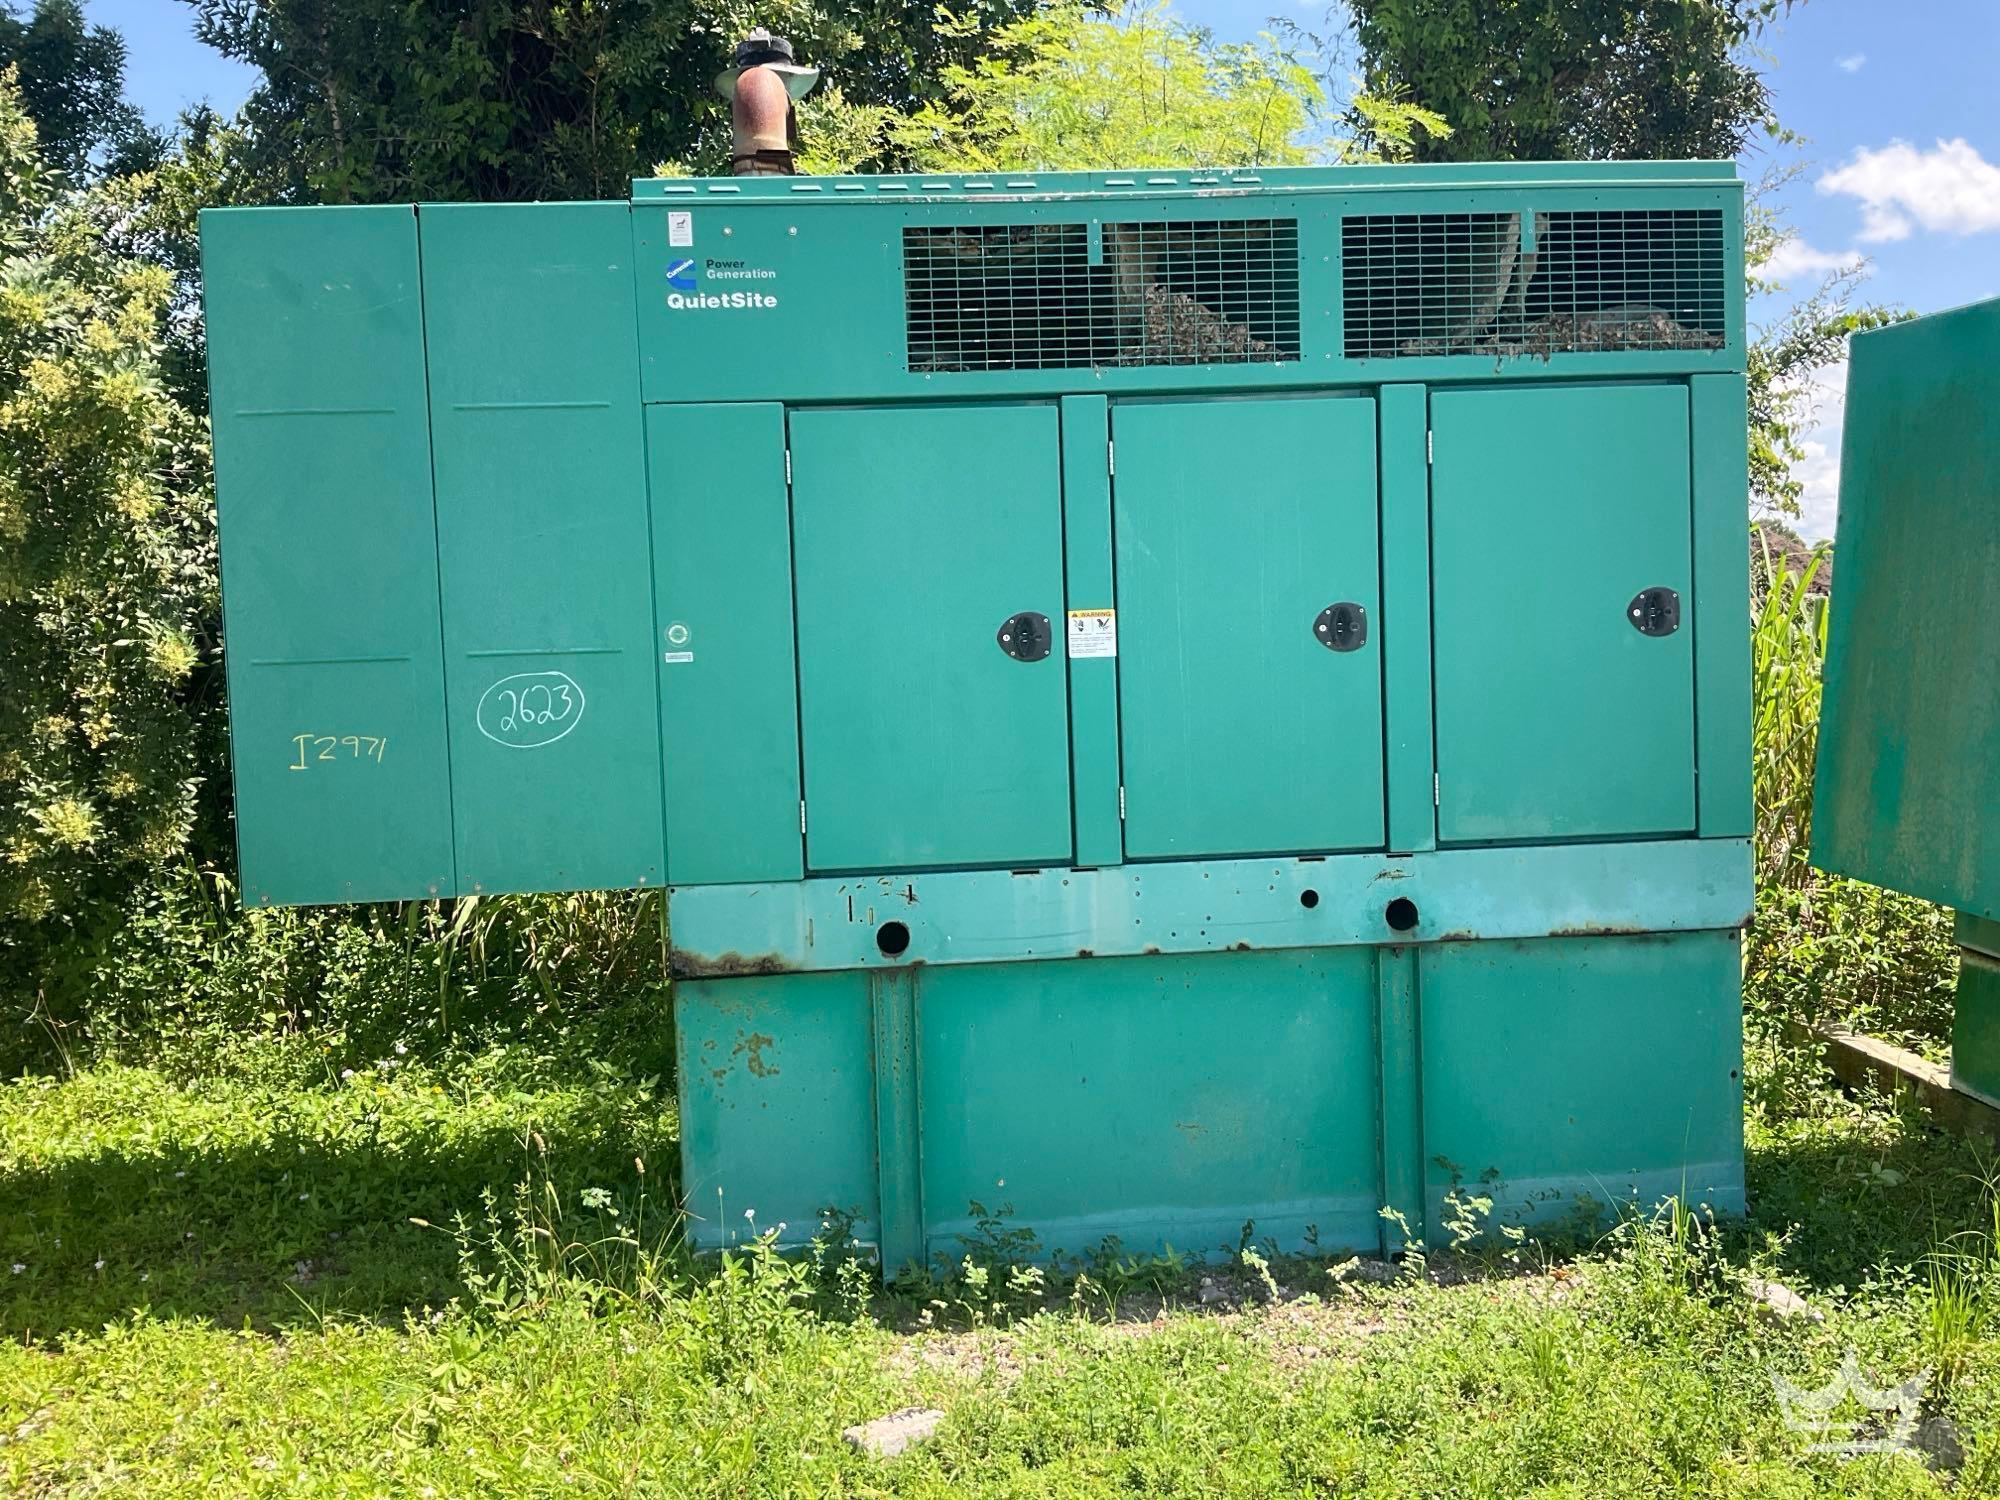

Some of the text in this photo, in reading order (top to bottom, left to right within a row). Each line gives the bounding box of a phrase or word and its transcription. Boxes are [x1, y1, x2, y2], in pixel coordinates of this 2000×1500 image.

[706, 259, 745, 269] Power
[706, 269, 776, 279] Generation
[667, 292, 778, 309] QuietSite
[498, 685, 573, 732] 2623
